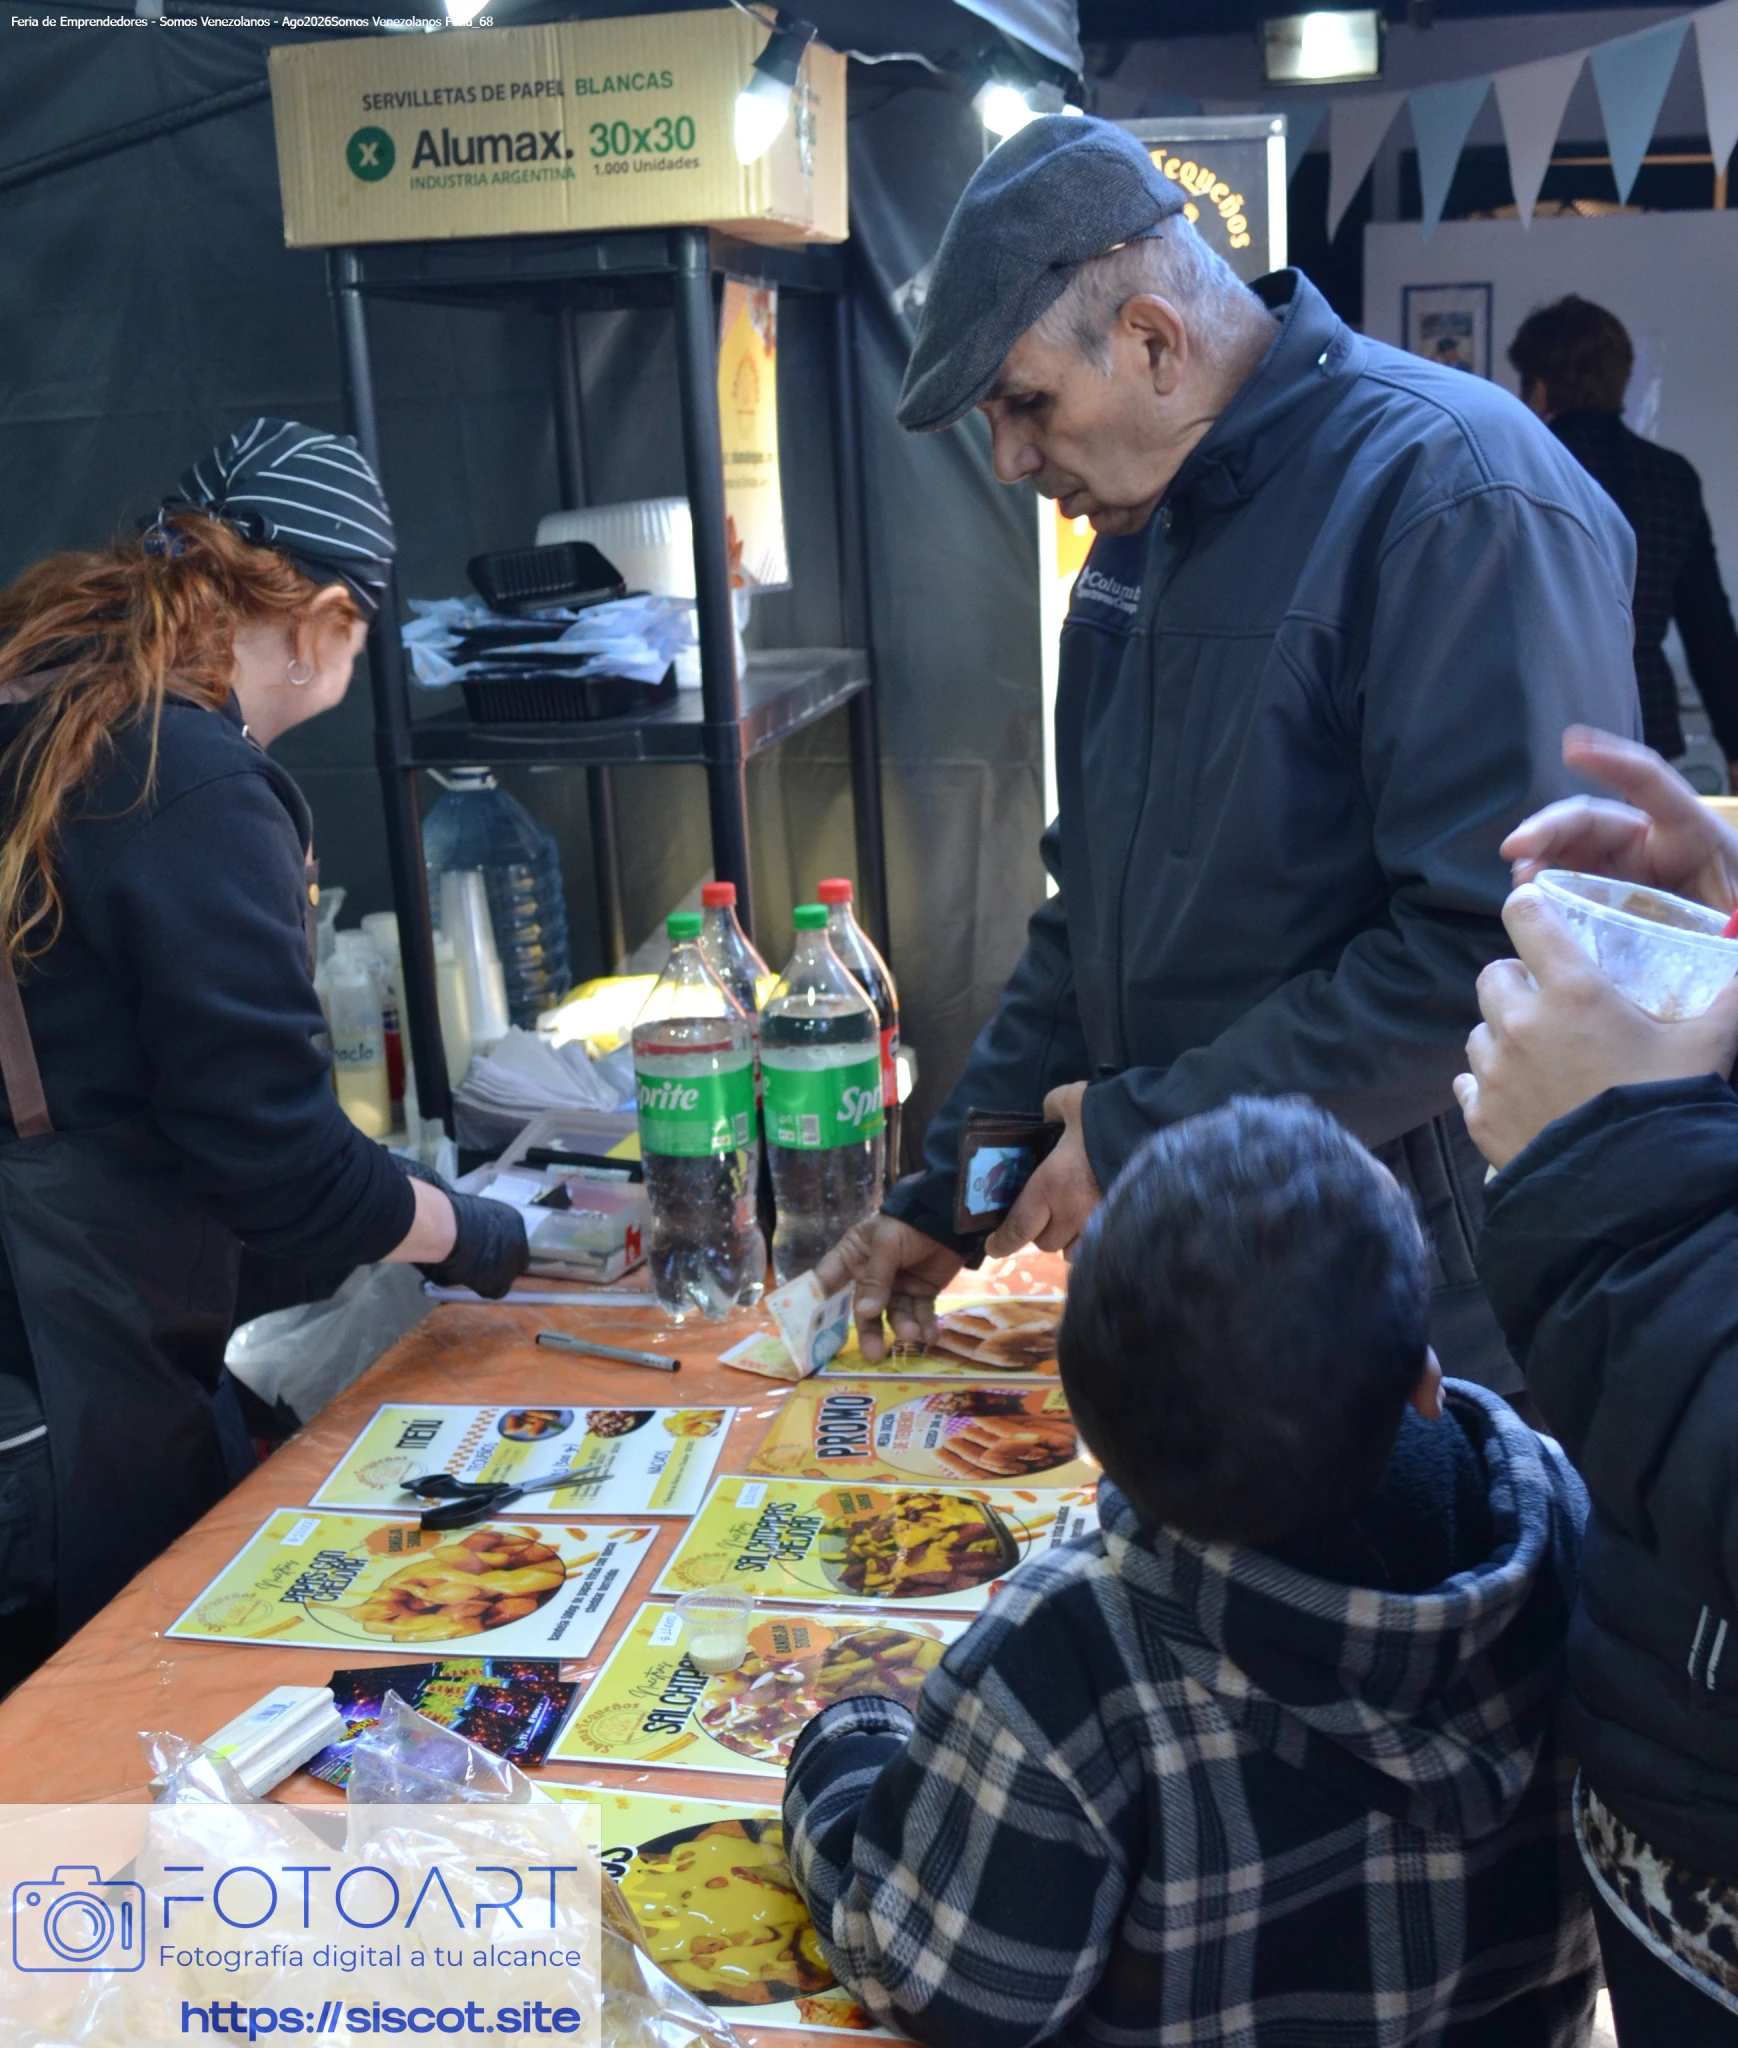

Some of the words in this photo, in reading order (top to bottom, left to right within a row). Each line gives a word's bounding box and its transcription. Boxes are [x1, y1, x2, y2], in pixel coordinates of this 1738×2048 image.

[362, 86, 477, 111] SERVILLETAS
[480, 84, 506, 102] DE
[510, 78, 564, 100] PAPEL
[575, 71, 674, 96] BLANCAS
[589, 115, 696, 157] 30x30
[410, 172, 488, 190] INDUSTRIA
[490, 167, 576, 186] ARGENTINA
[594, 160, 629, 176] 1.000
[633, 157, 700, 173] Unidades
[638, 1079, 699, 1111] prite
[817, 1395, 875, 1459] PROMO
[735, 1502, 799, 1573] SALCHIPAPAS
